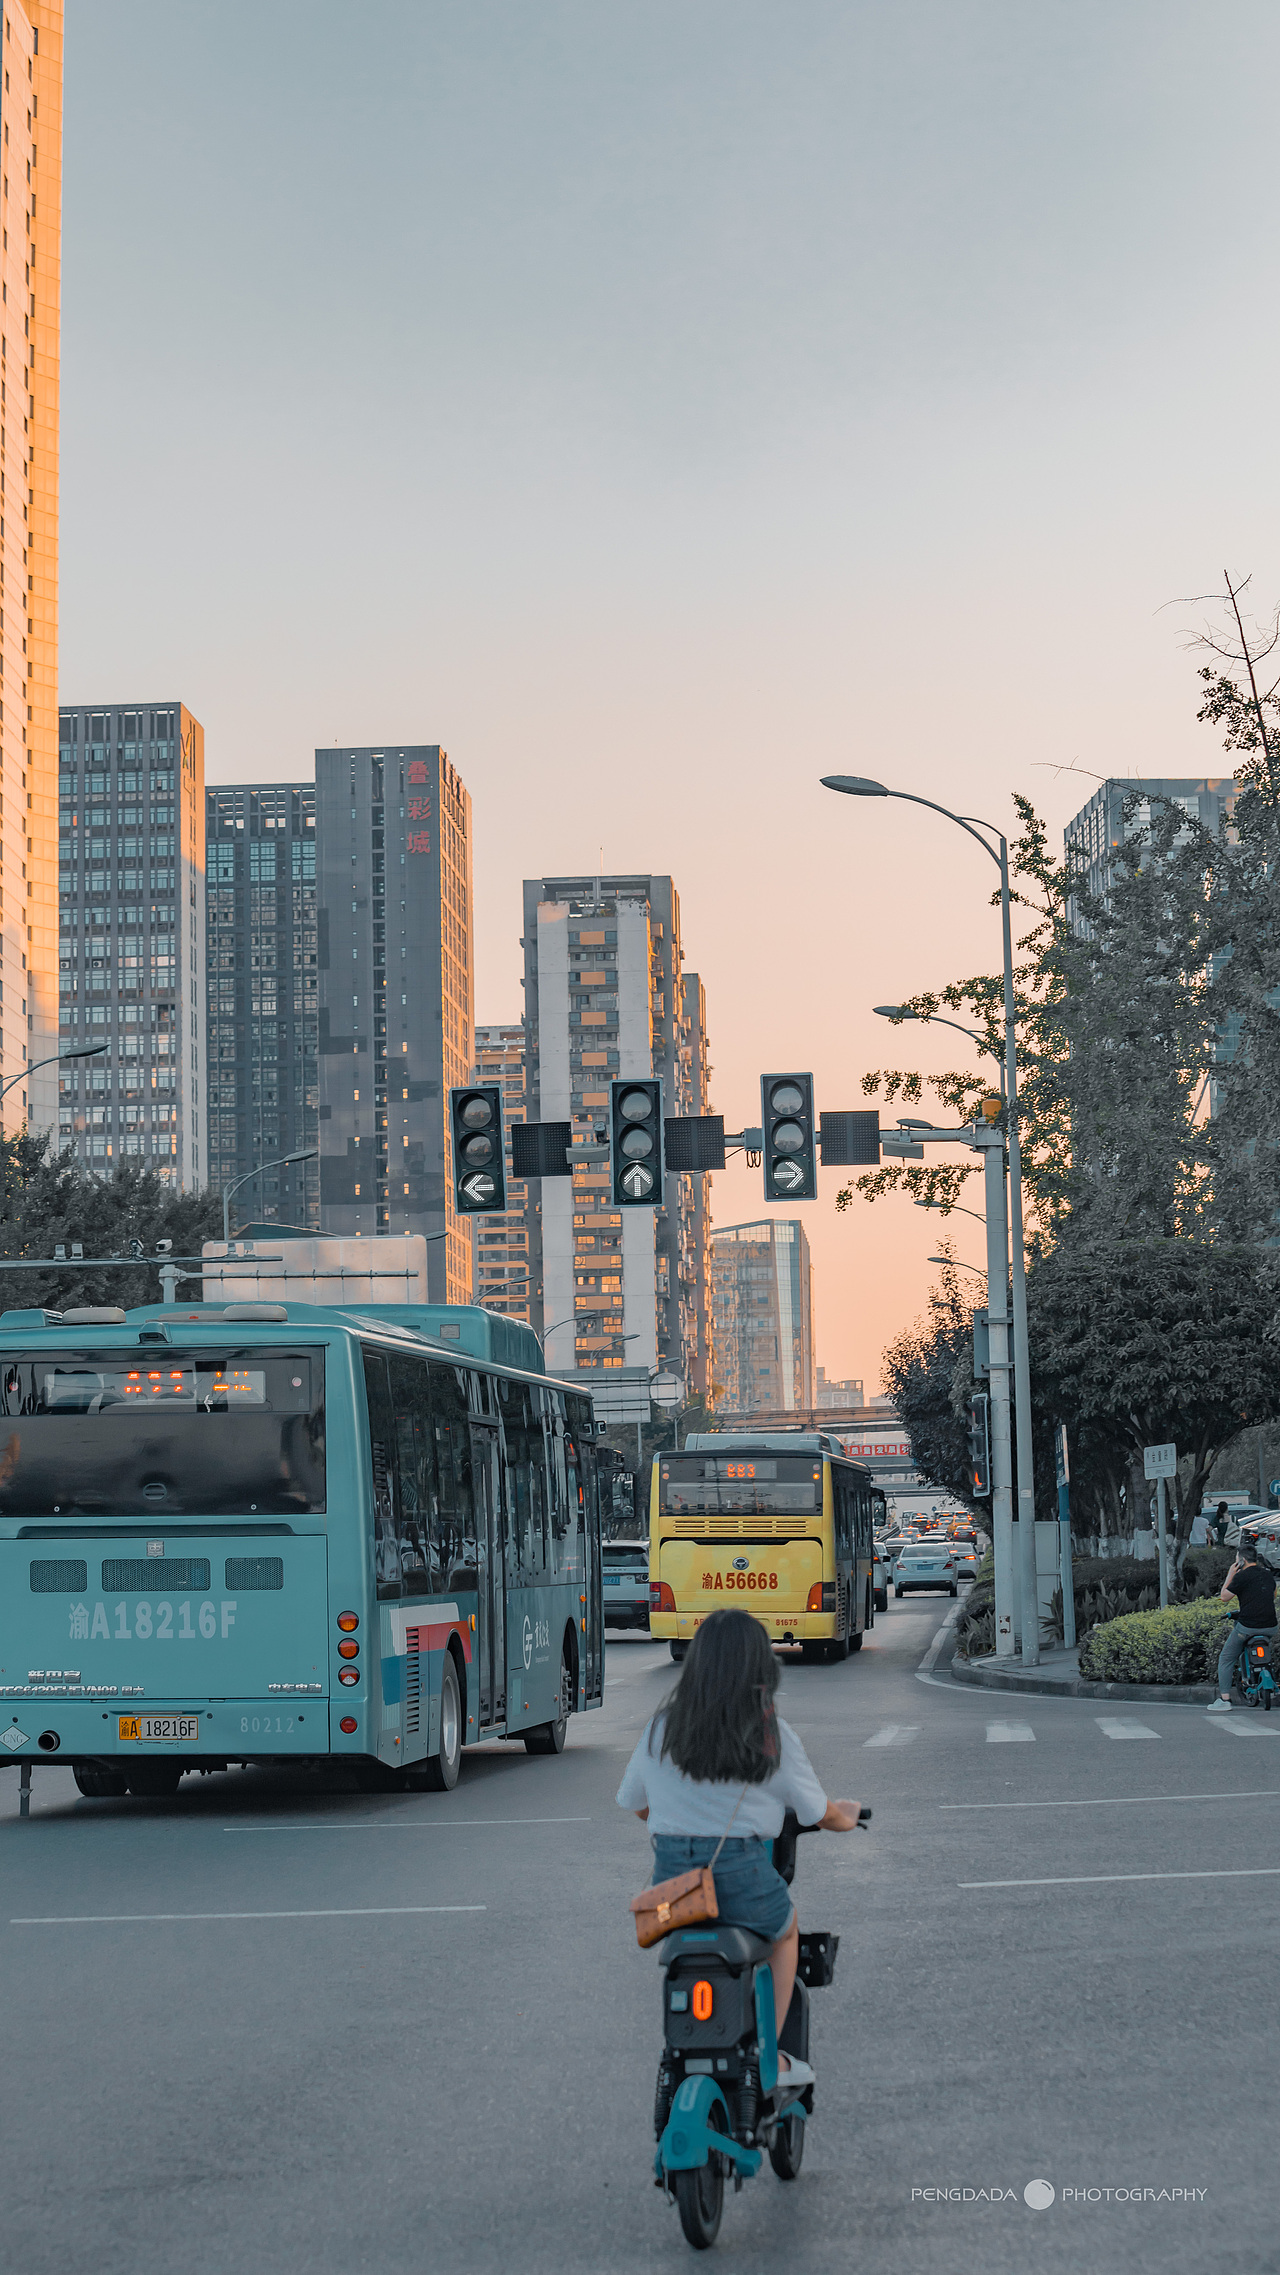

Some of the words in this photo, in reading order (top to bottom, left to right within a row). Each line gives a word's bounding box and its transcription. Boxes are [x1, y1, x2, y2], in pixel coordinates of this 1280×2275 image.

[407, 760, 432, 853] 叠彩城
[702, 1572, 778, 1590] 渝A56668
[69, 1600, 238, 1640] 渝A18216F
[775, 1619, 798, 1627] 81675
[240, 1717, 295, 1734] 80212
[3, 1733, 23, 1744] CNG
